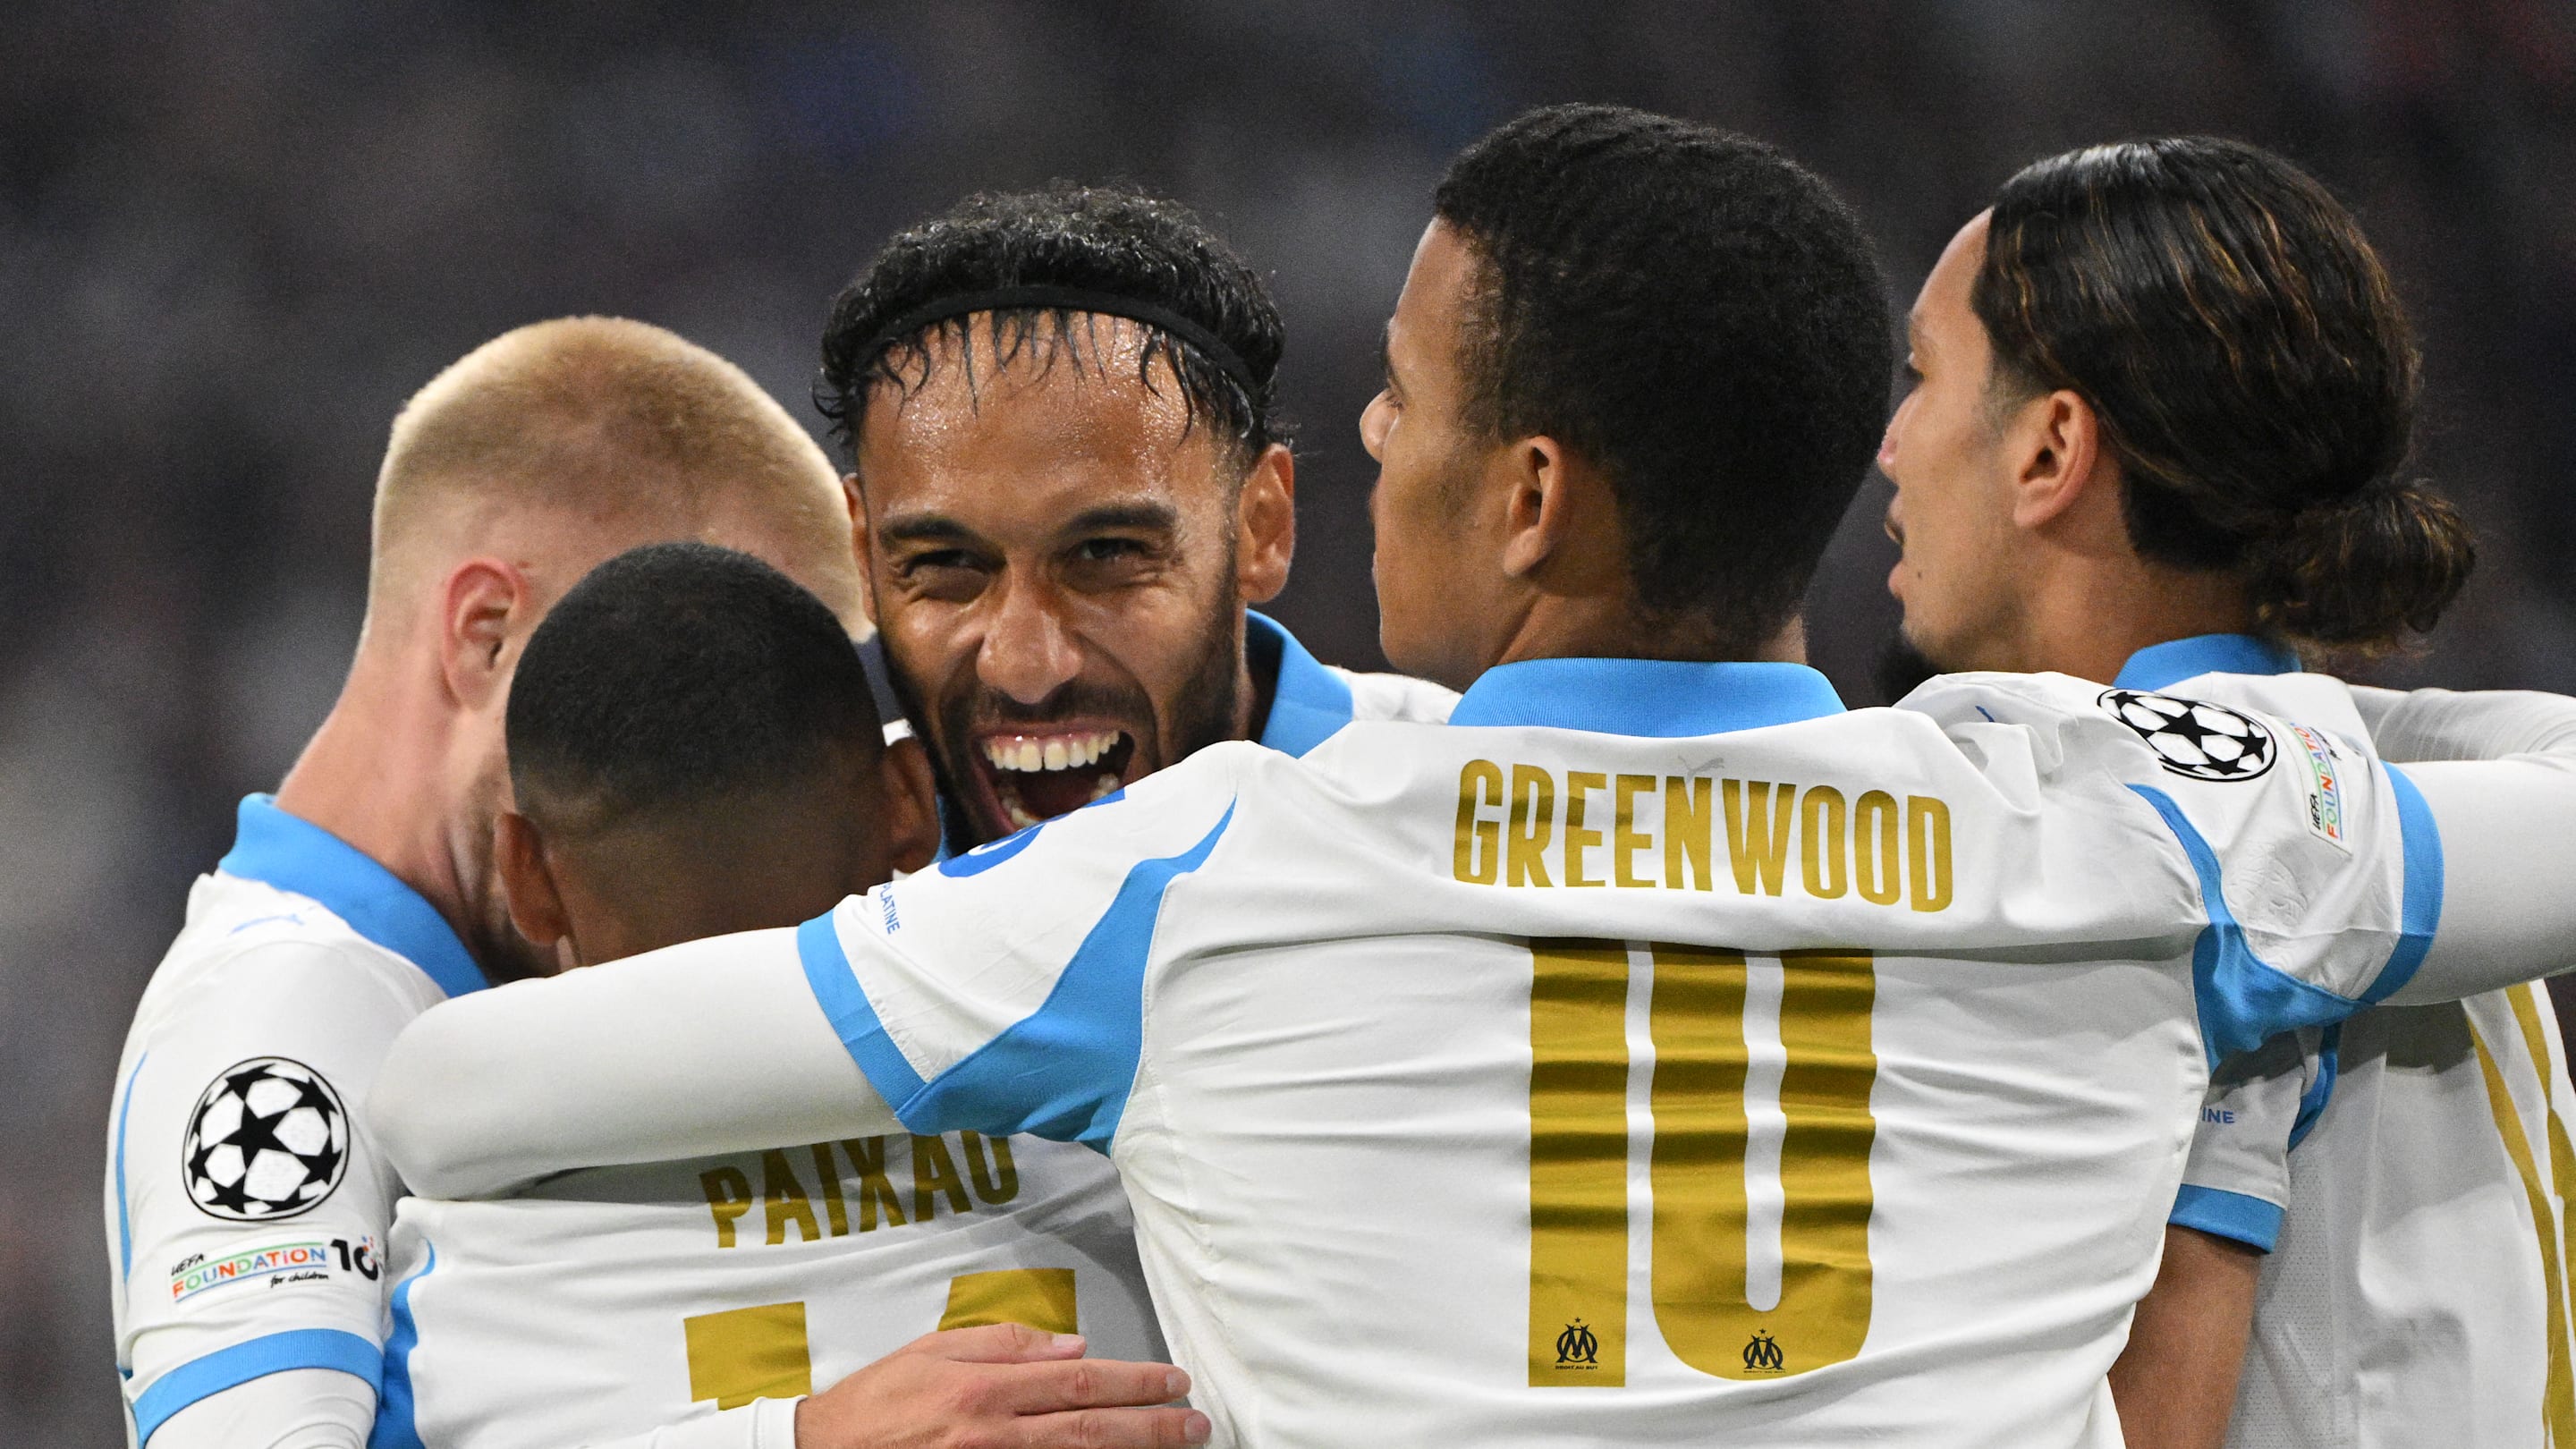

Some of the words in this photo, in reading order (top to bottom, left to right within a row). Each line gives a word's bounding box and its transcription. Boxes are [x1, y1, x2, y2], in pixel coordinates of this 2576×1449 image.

[2309, 793, 2321, 831] UEFA
[1453, 758, 1953, 912] GREENWOOD
[1528, 936, 1877, 1388] 10
[171, 1253, 205, 1276] UEFA
[270, 1274, 284, 1289] for
[288, 1271, 329, 1283] children
